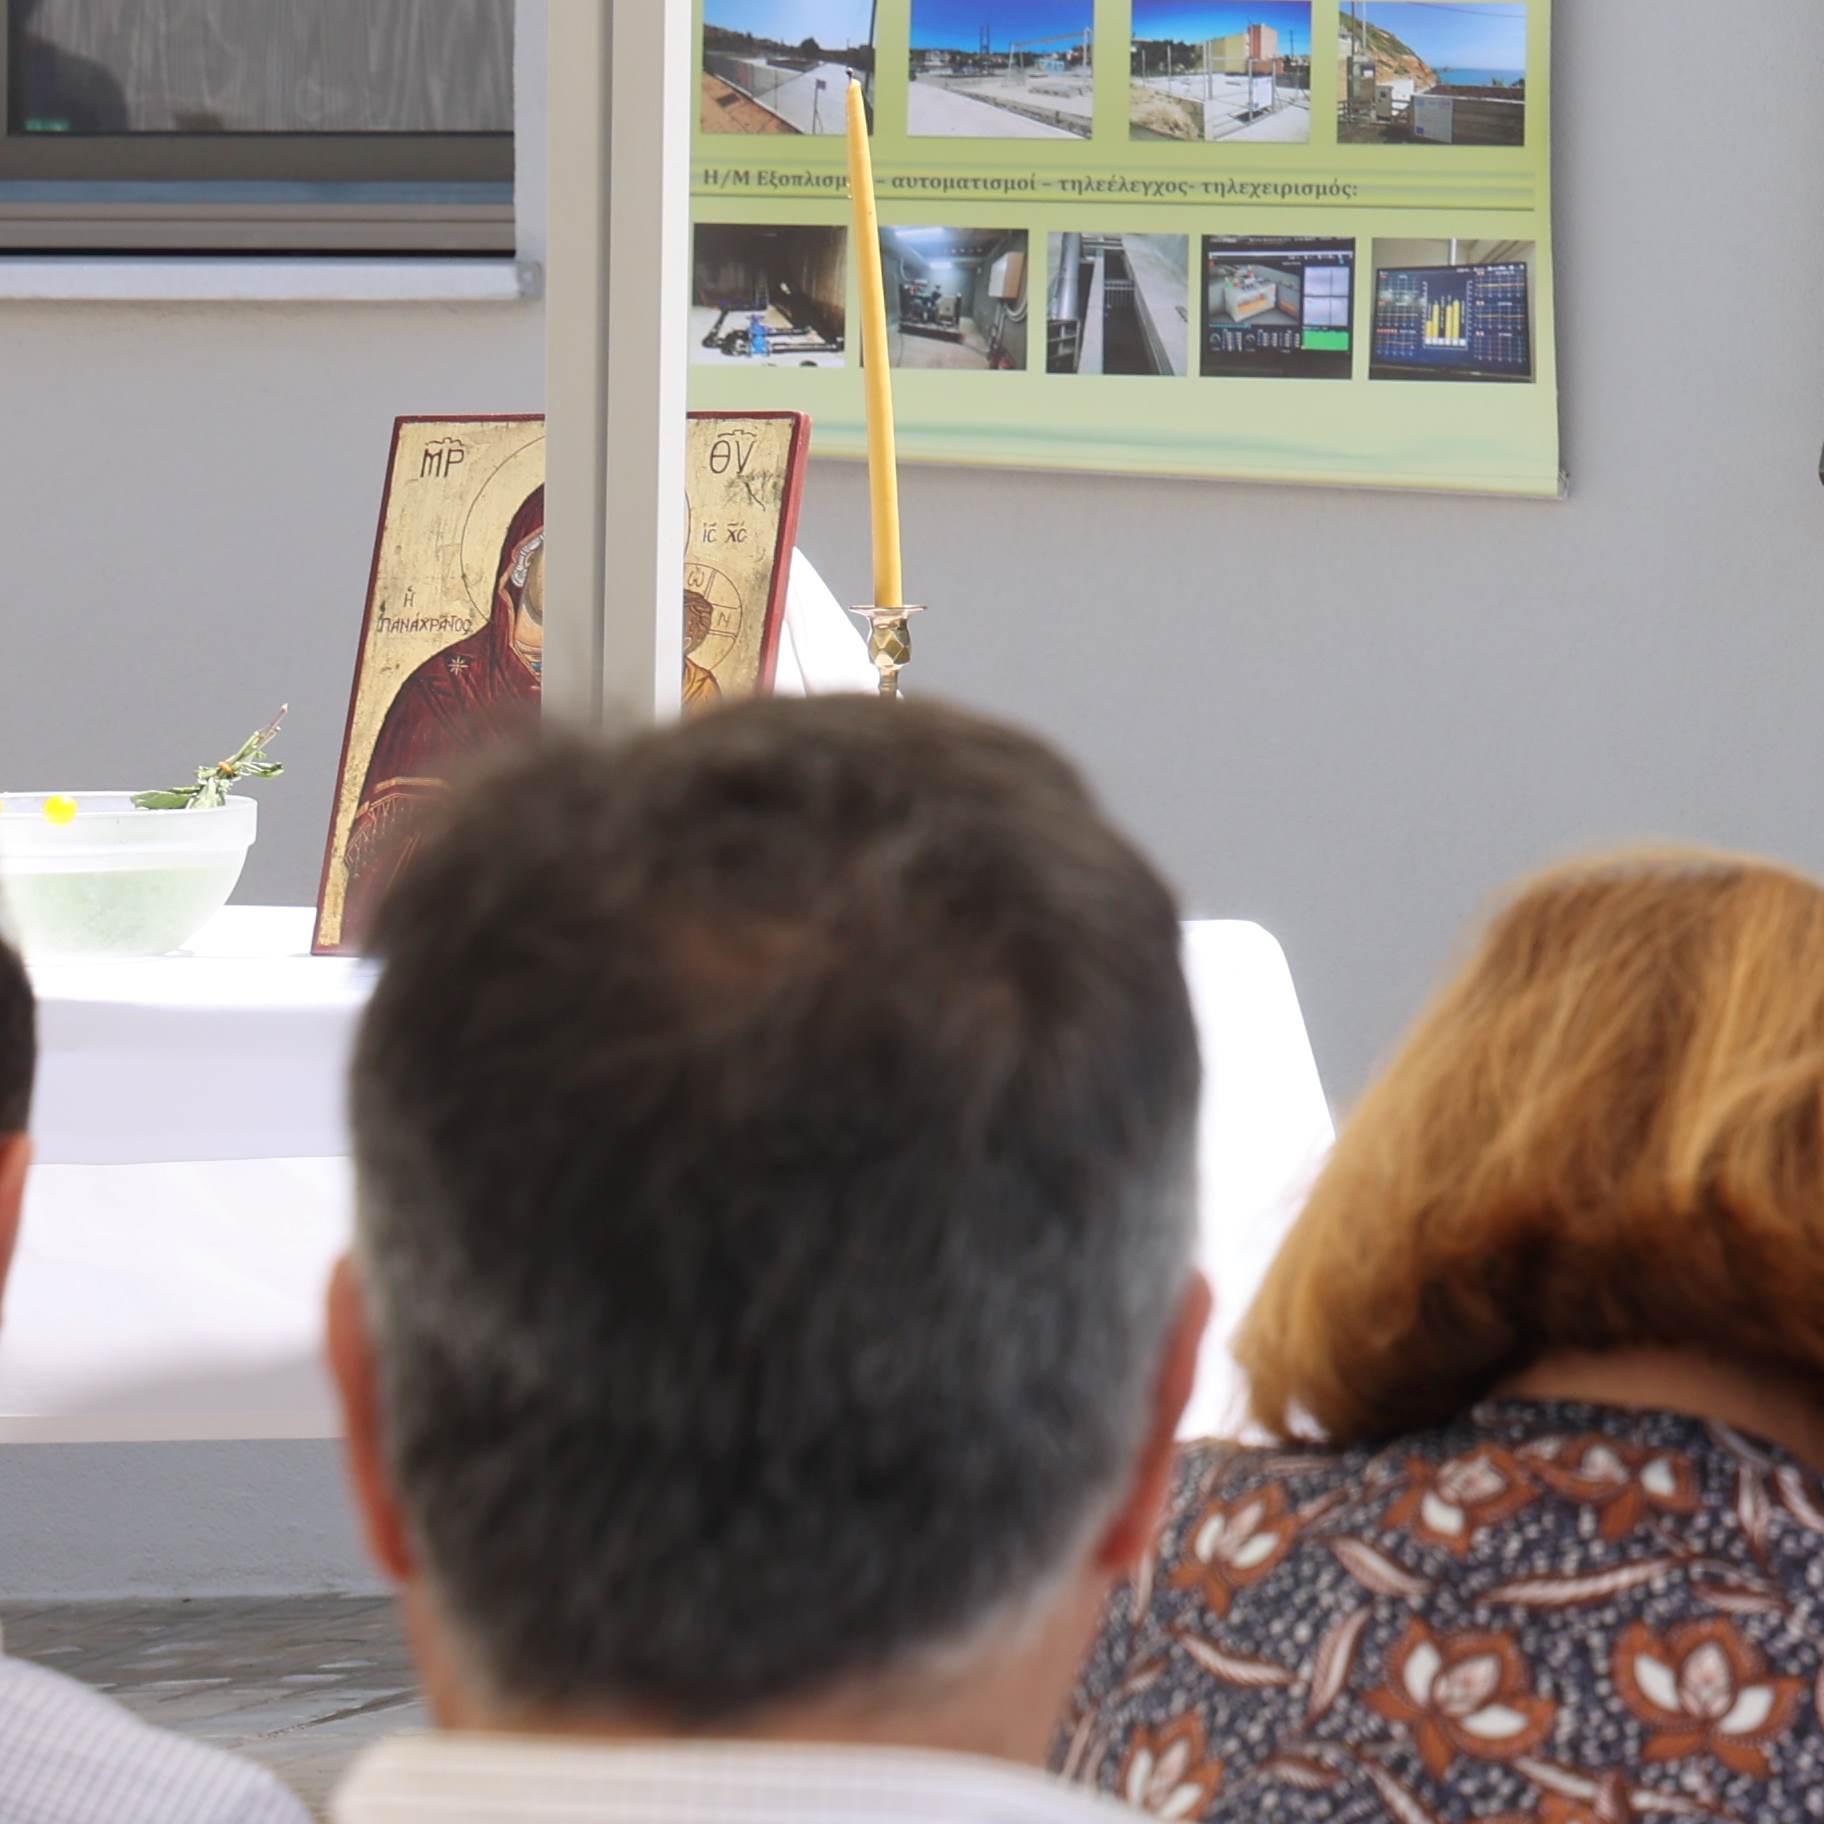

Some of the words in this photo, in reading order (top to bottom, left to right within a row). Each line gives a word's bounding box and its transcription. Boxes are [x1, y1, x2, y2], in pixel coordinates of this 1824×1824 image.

[704, 170, 750, 188] Η/Μ
[758, 171, 847, 192] Εξοπλισμ
[891, 174, 1036, 194] αυτοματισμοί
[1057, 175, 1195, 196] τηλεέλεγχος-
[1200, 178, 1358, 200] τηλεχειρισμός:
